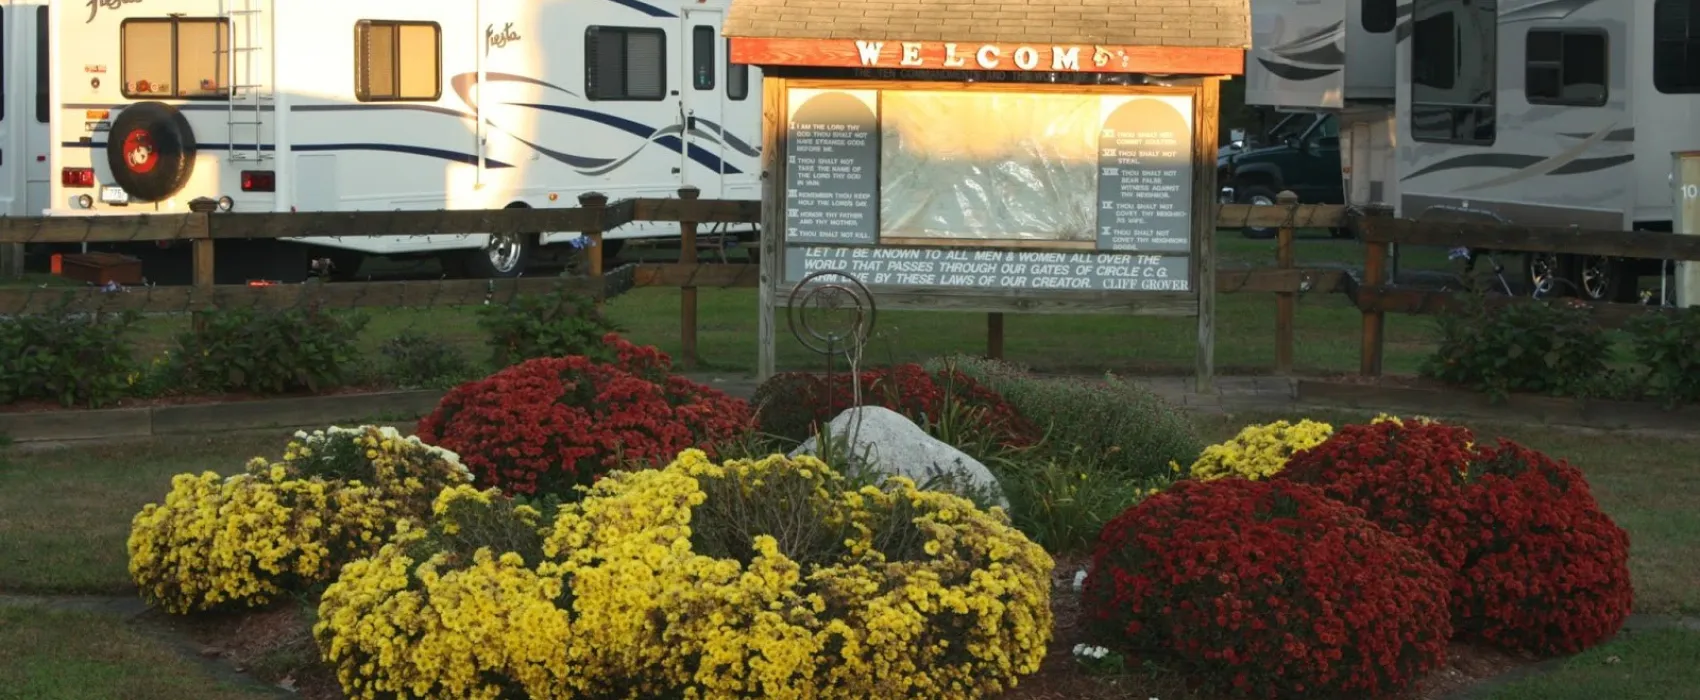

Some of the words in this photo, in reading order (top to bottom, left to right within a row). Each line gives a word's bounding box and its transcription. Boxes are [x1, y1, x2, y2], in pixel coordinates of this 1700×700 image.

[1681, 184, 1697, 198] 10
[834, 247, 850, 258] IT
[852, 248, 869, 258] BE
[873, 248, 920, 259] KNOWN
[924, 249, 941, 260] TO
[947, 250, 968, 260] ALL
[974, 250, 1002, 261] MEN
[1005, 252, 1013, 262] &
[1019, 252, 1066, 263] WOMEN
[1070, 253, 1093, 264] ALL
[1097, 254, 1131, 265] OVER
[1137, 255, 1162, 265] THE
[804, 259, 848, 270] WORLD
[852, 260, 883, 271] THAT
[887, 261, 934, 272] PASSES
[940, 262, 997, 273] THROUGH
[1001, 263, 1026, 275] OUR
[1031, 264, 1070, 275] GATES
[1075, 265, 1094, 276] OF
[1096, 266, 1140, 277] CIRCLE
[874, 273, 891, 284] BY
[896, 274, 936, 285] THESE
[940, 274, 976, 285] LAWS
[978, 275, 996, 286] OF
[1001, 276, 1026, 287] OUR
[1032, 276, 1092, 288] CREATOR.
[1102, 278, 1137, 290] CLIFF
[1141, 279, 1189, 291] GROVER
